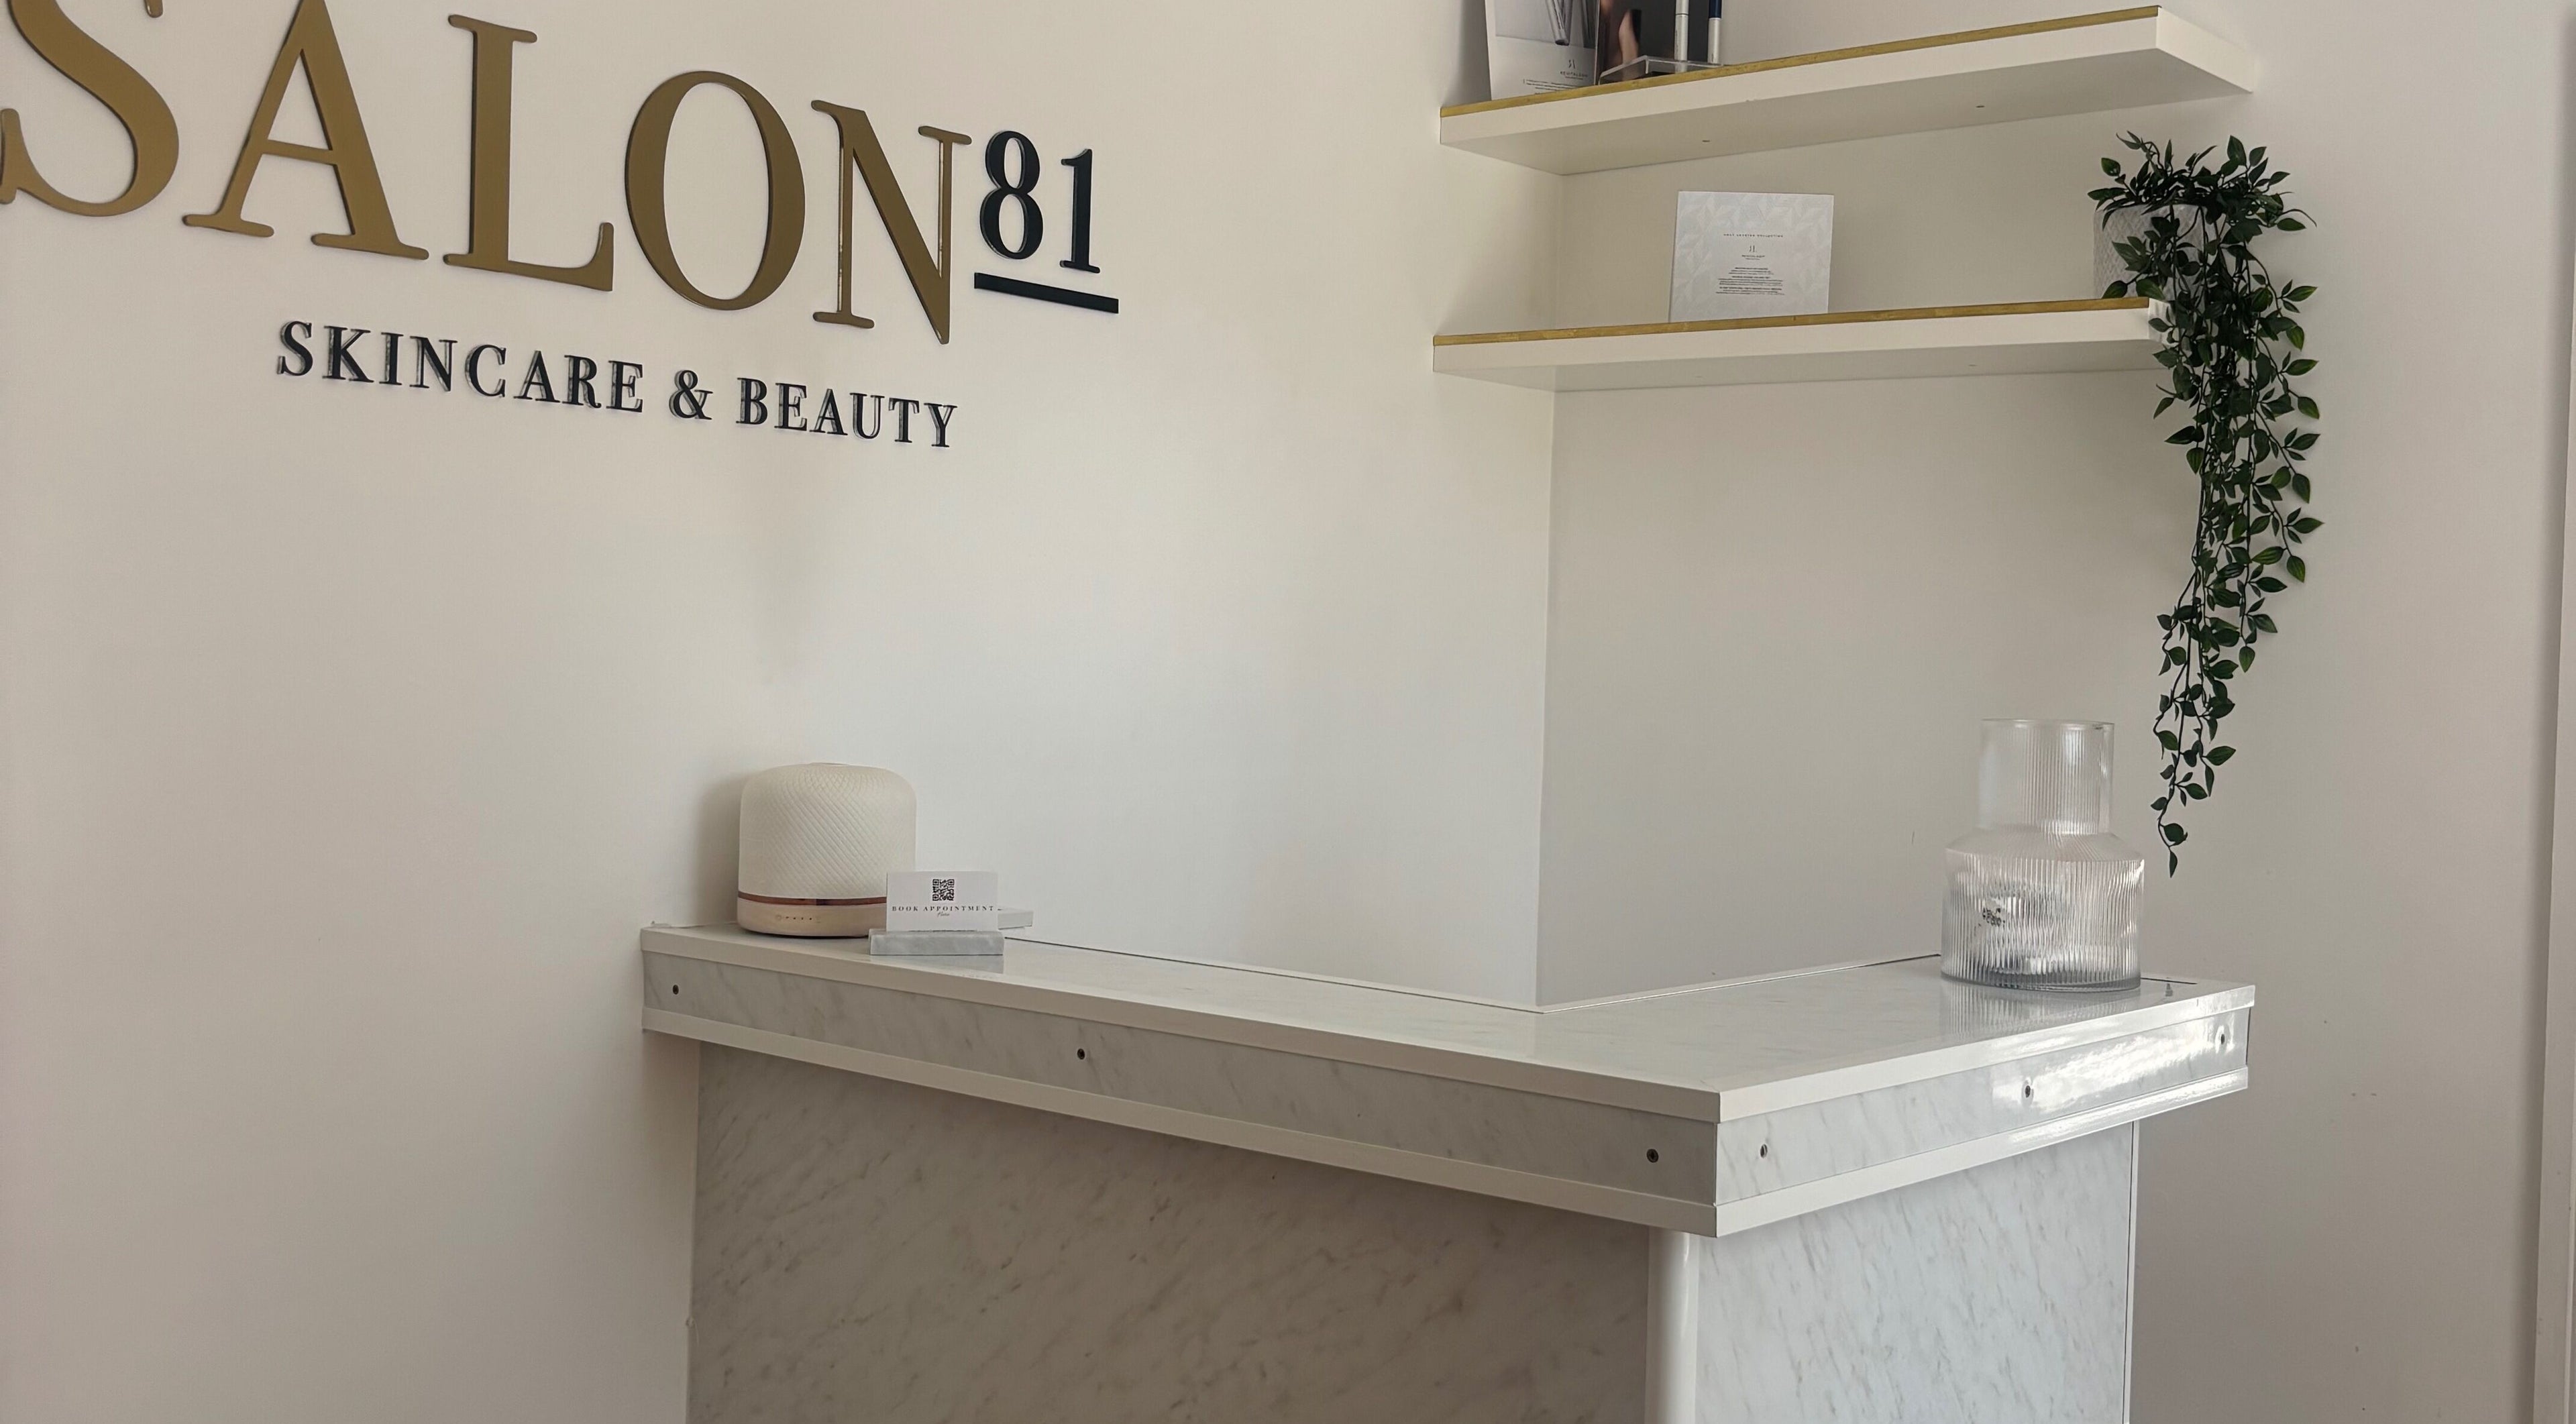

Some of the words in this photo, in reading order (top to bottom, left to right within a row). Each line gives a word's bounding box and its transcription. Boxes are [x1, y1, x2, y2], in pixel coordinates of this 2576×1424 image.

[0, 0, 972, 345] SALON
[979, 130, 1101, 274] 81
[276, 320, 644, 413] SKINCARE
[668, 369, 714, 421] &
[735, 376, 958, 448] BEAUTY
